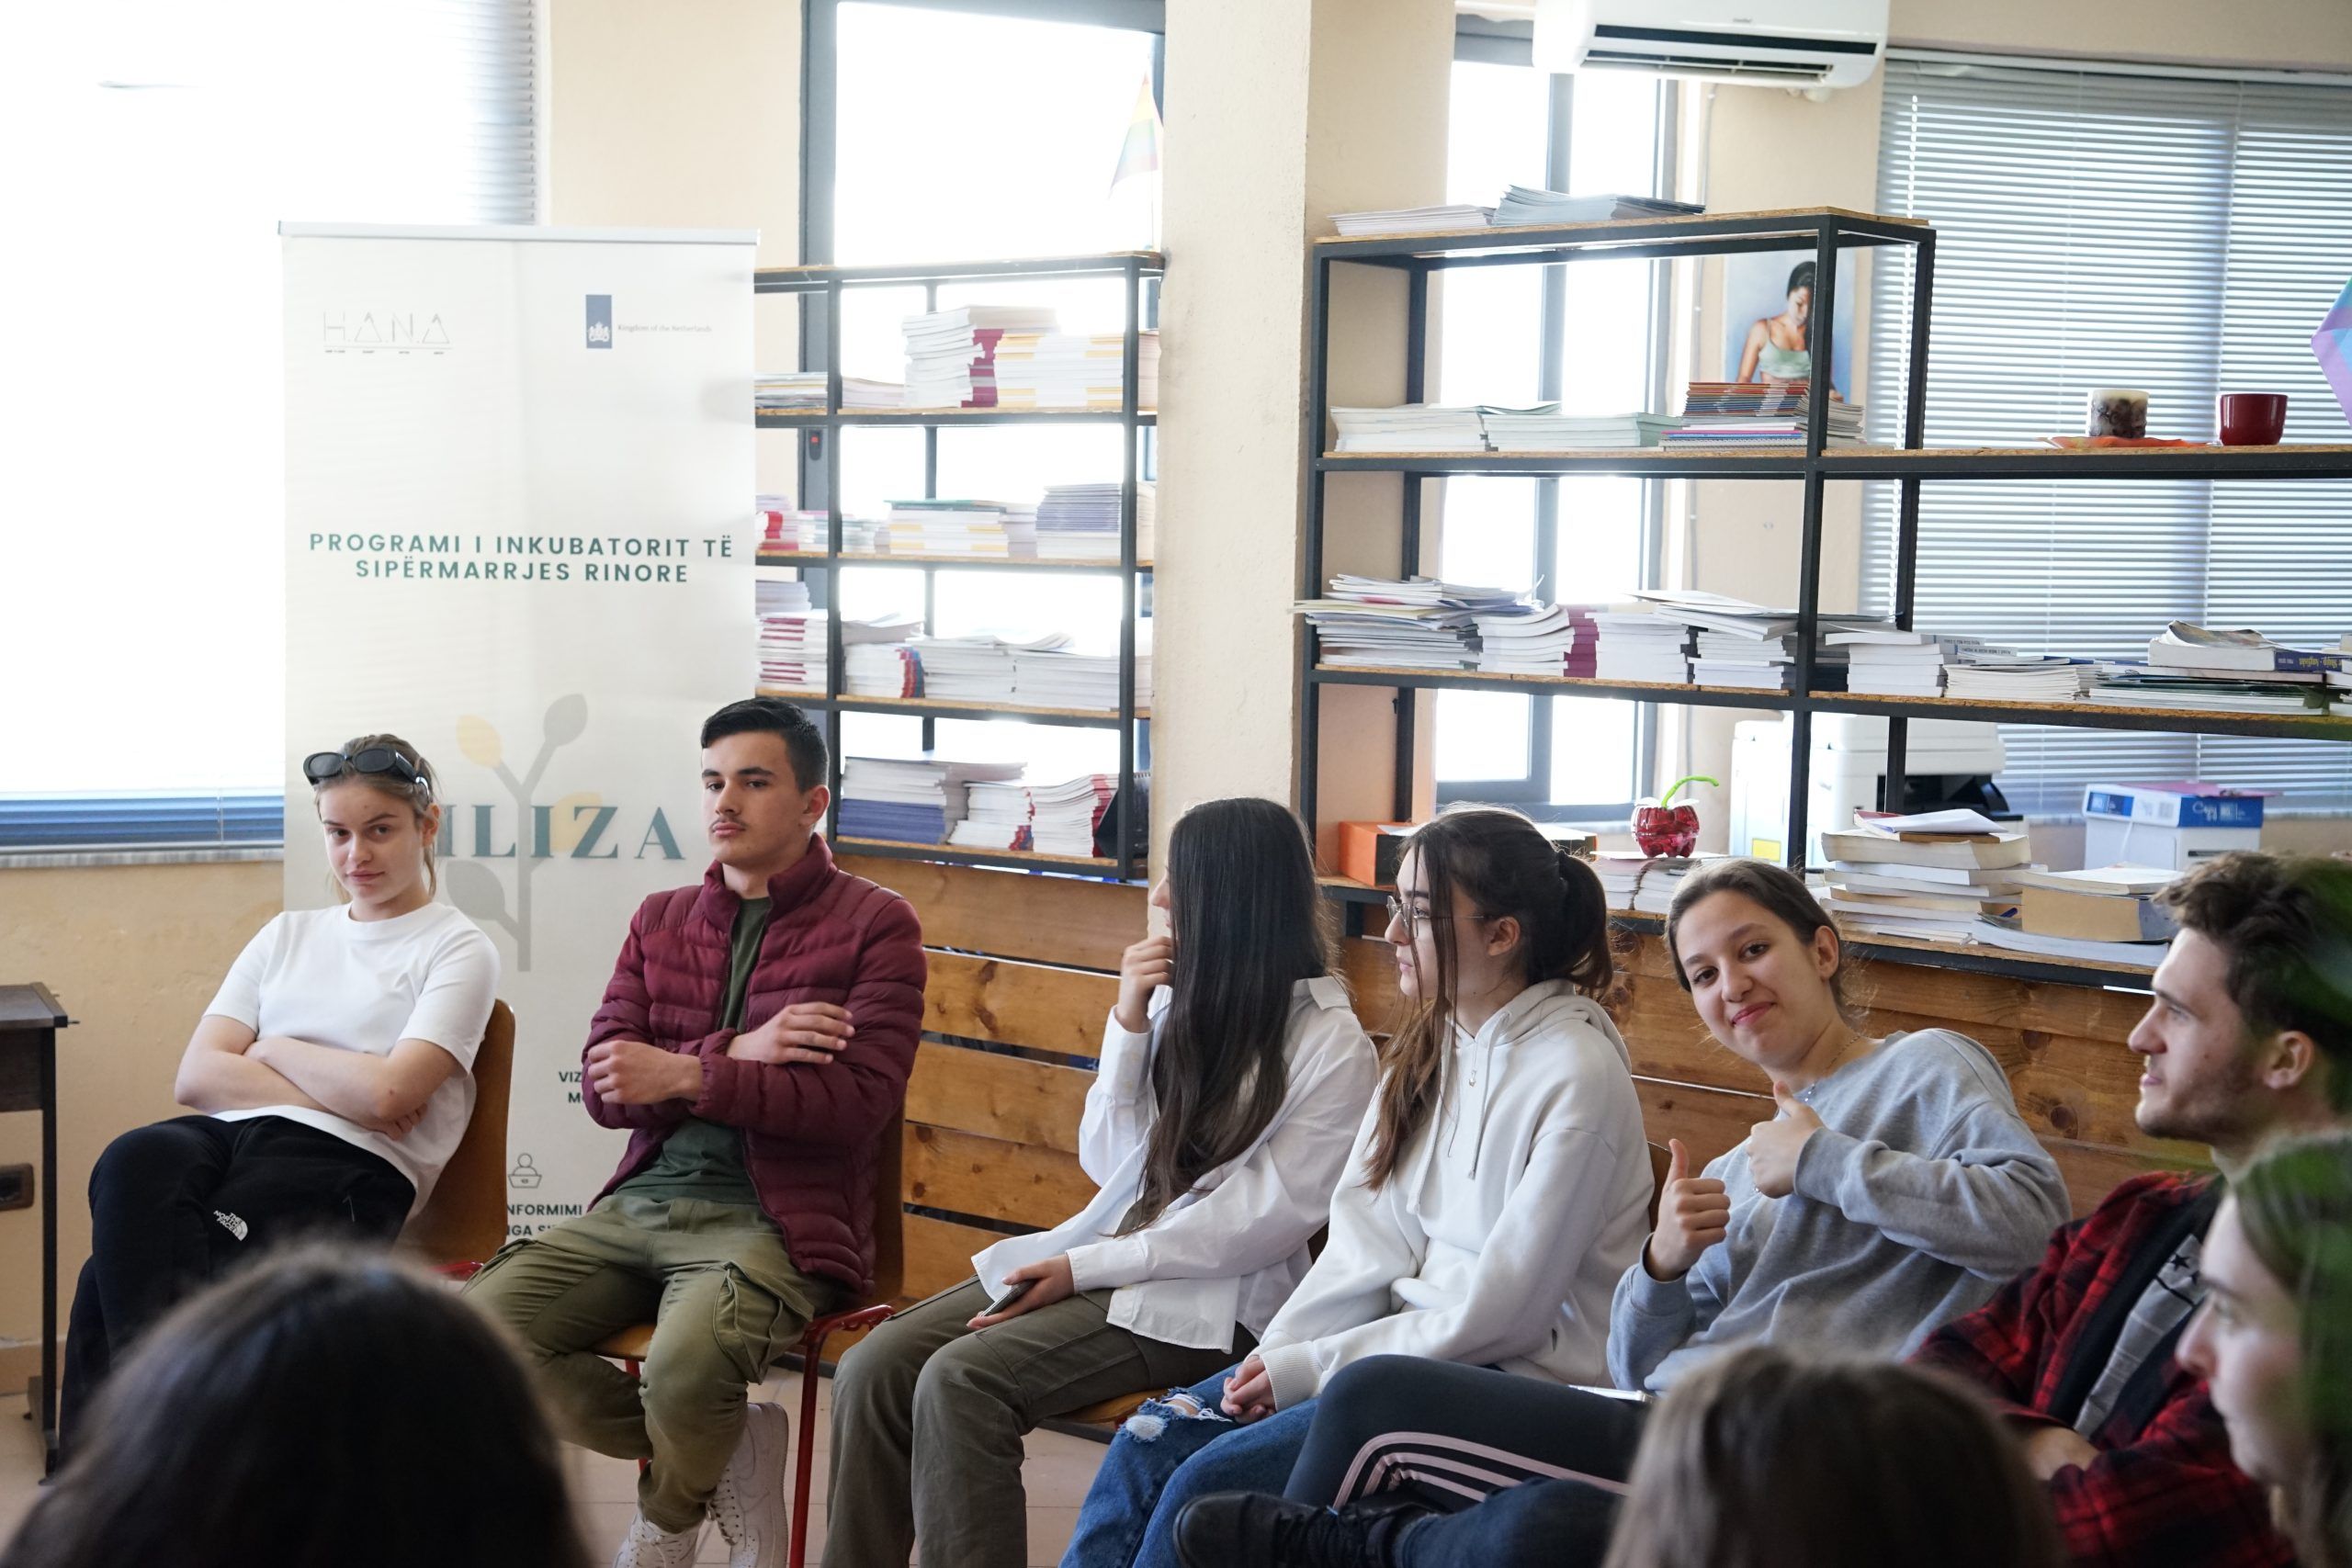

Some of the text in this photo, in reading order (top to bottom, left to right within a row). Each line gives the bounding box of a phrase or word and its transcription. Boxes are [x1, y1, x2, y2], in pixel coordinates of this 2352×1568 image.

[617, 323, 713, 333] Kingdom of the Netherlands
[310, 534, 732, 558] PROGRAMI I INKUBATORIT TË
[356, 555, 687, 583] SIPËRMARRJES RINORE
[435, 804, 686, 861] ILIZA
[506, 1204, 582, 1216] NFORMIMI
